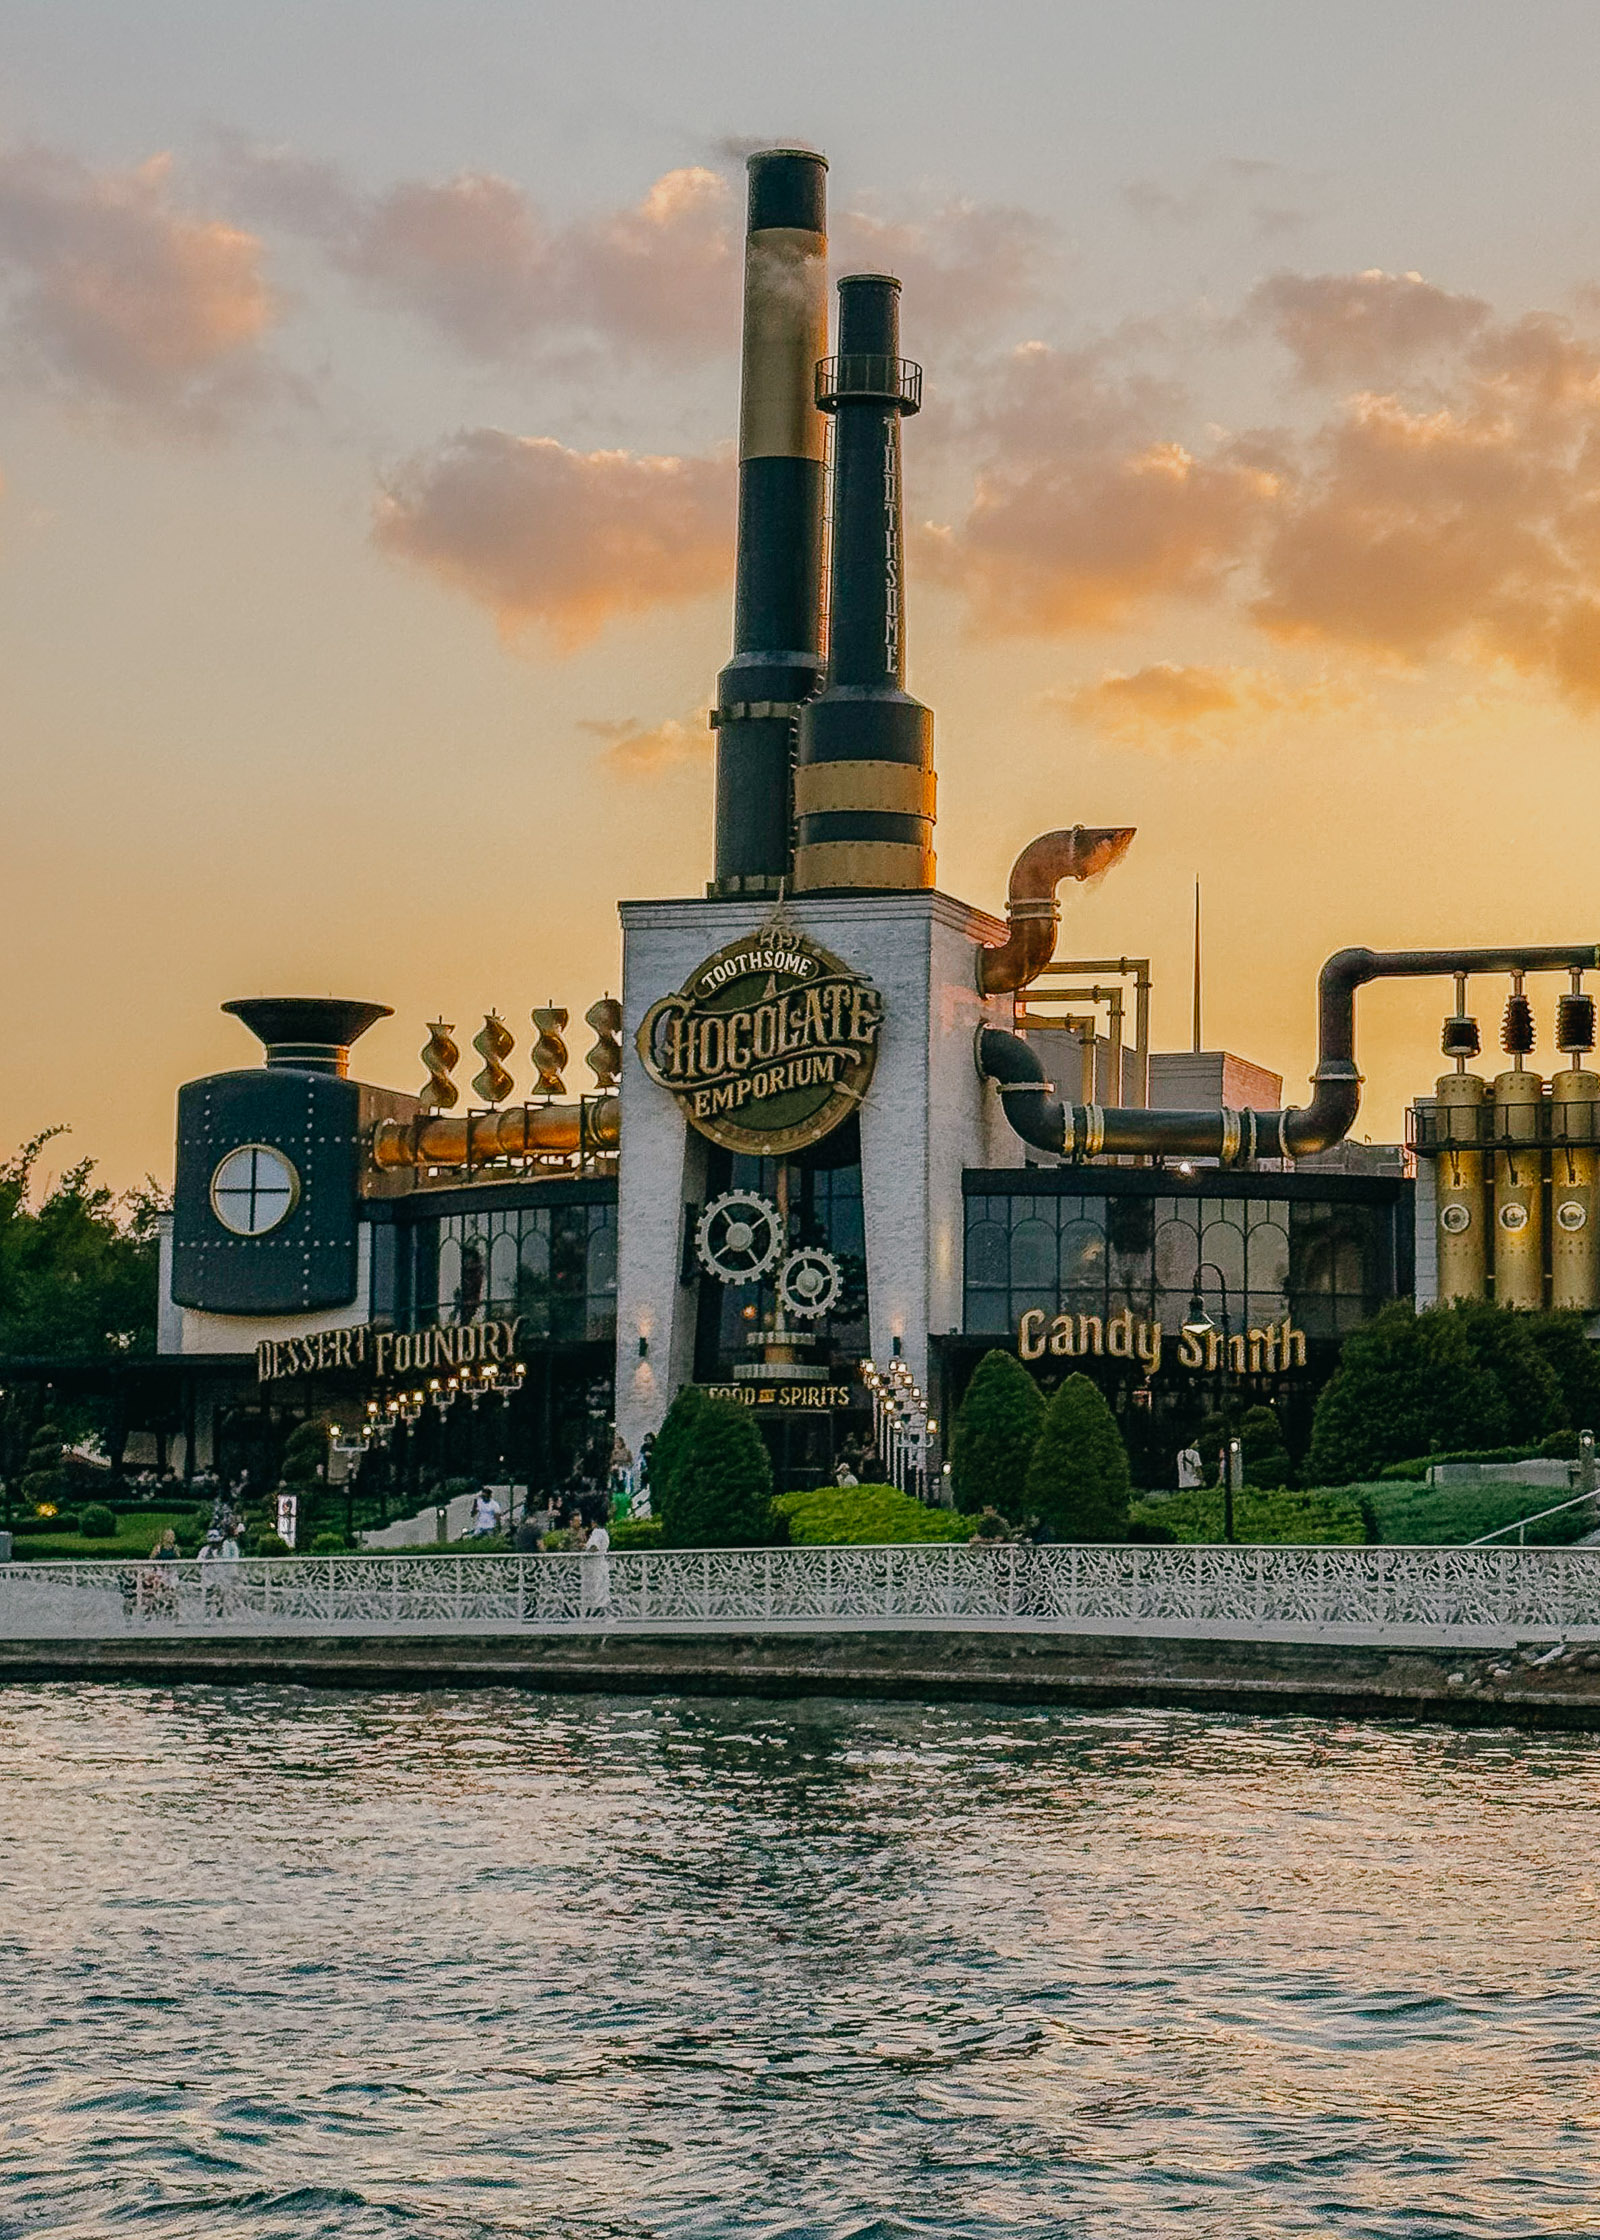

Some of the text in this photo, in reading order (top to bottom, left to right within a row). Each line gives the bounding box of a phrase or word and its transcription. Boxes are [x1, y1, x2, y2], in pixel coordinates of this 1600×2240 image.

[702, 950, 812, 990] TOOTHSOME
[635, 984, 884, 1090] CHOCOLATE
[694, 1055, 836, 1117] EMPORIUM
[257, 1316, 526, 1381] DESSERT FOUNDRY
[1018, 1307, 1161, 1375] Candy
[778, 1386, 849, 1407] SPIRITS
